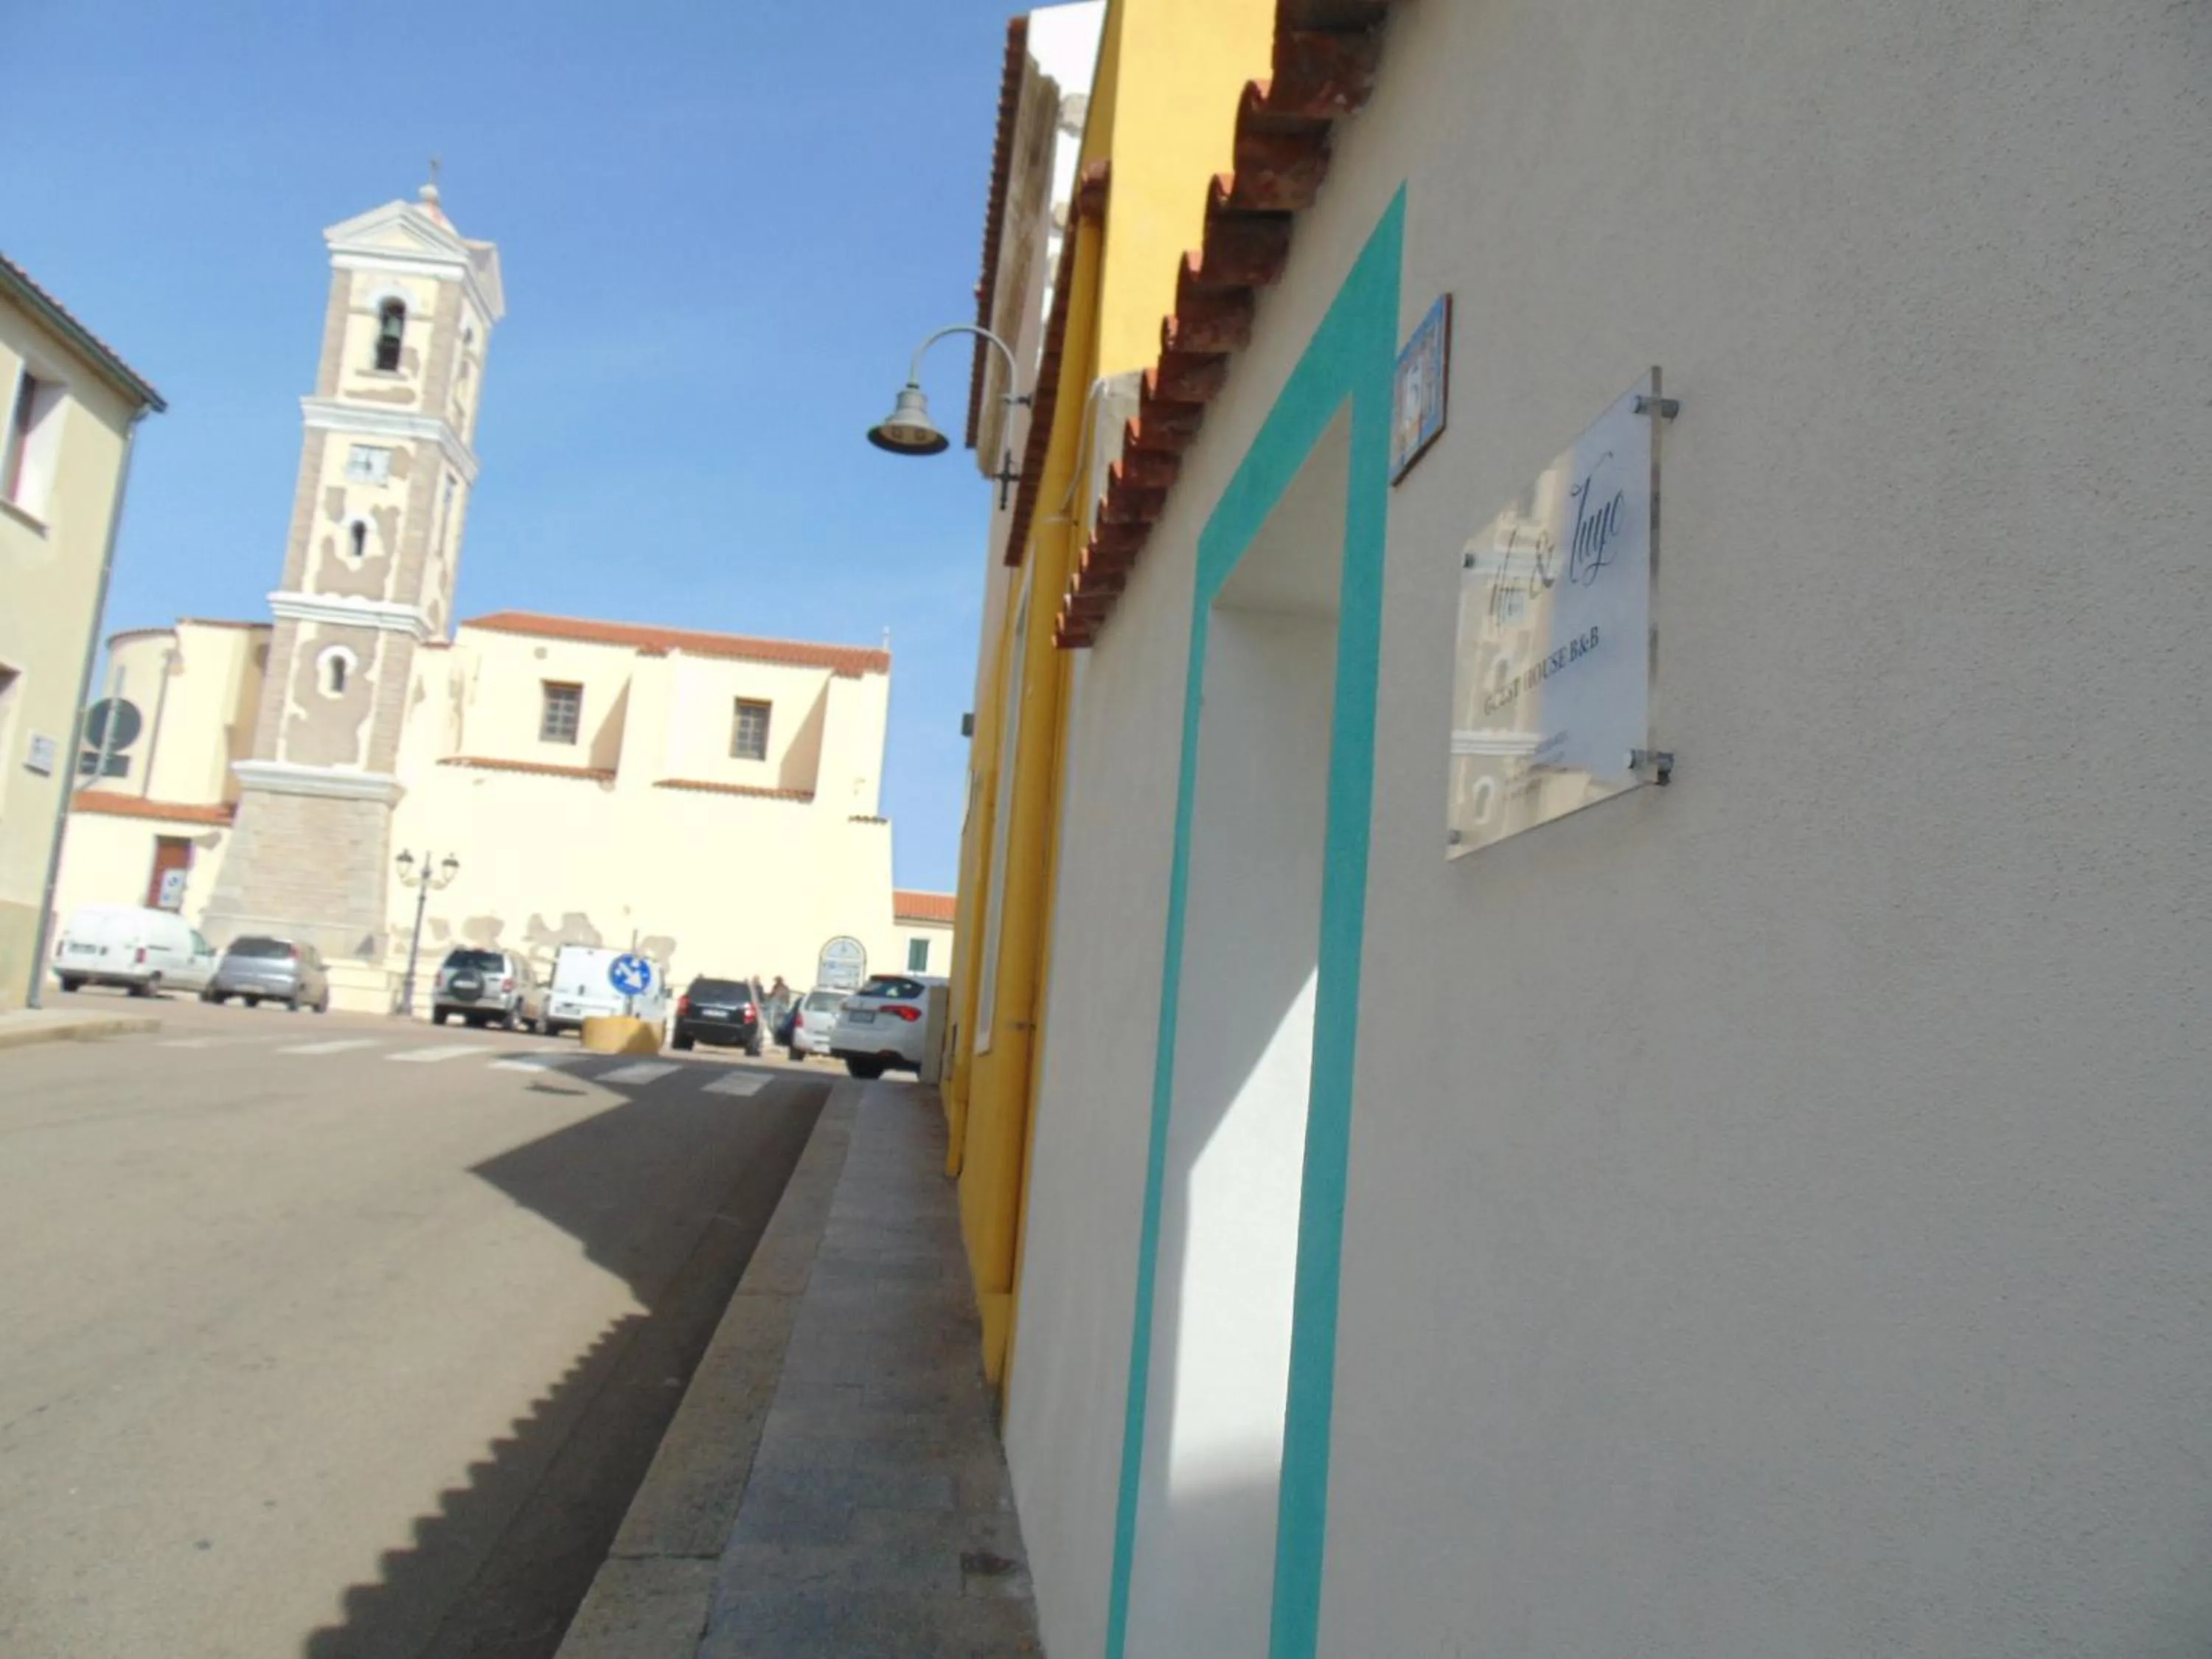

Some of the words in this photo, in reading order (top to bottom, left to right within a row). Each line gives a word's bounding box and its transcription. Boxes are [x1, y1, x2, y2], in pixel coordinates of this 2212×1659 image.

[1484, 676, 1522, 717] GST
[1523, 647, 1568, 692] HOUSE
[1568, 625, 1599, 663] B&B
